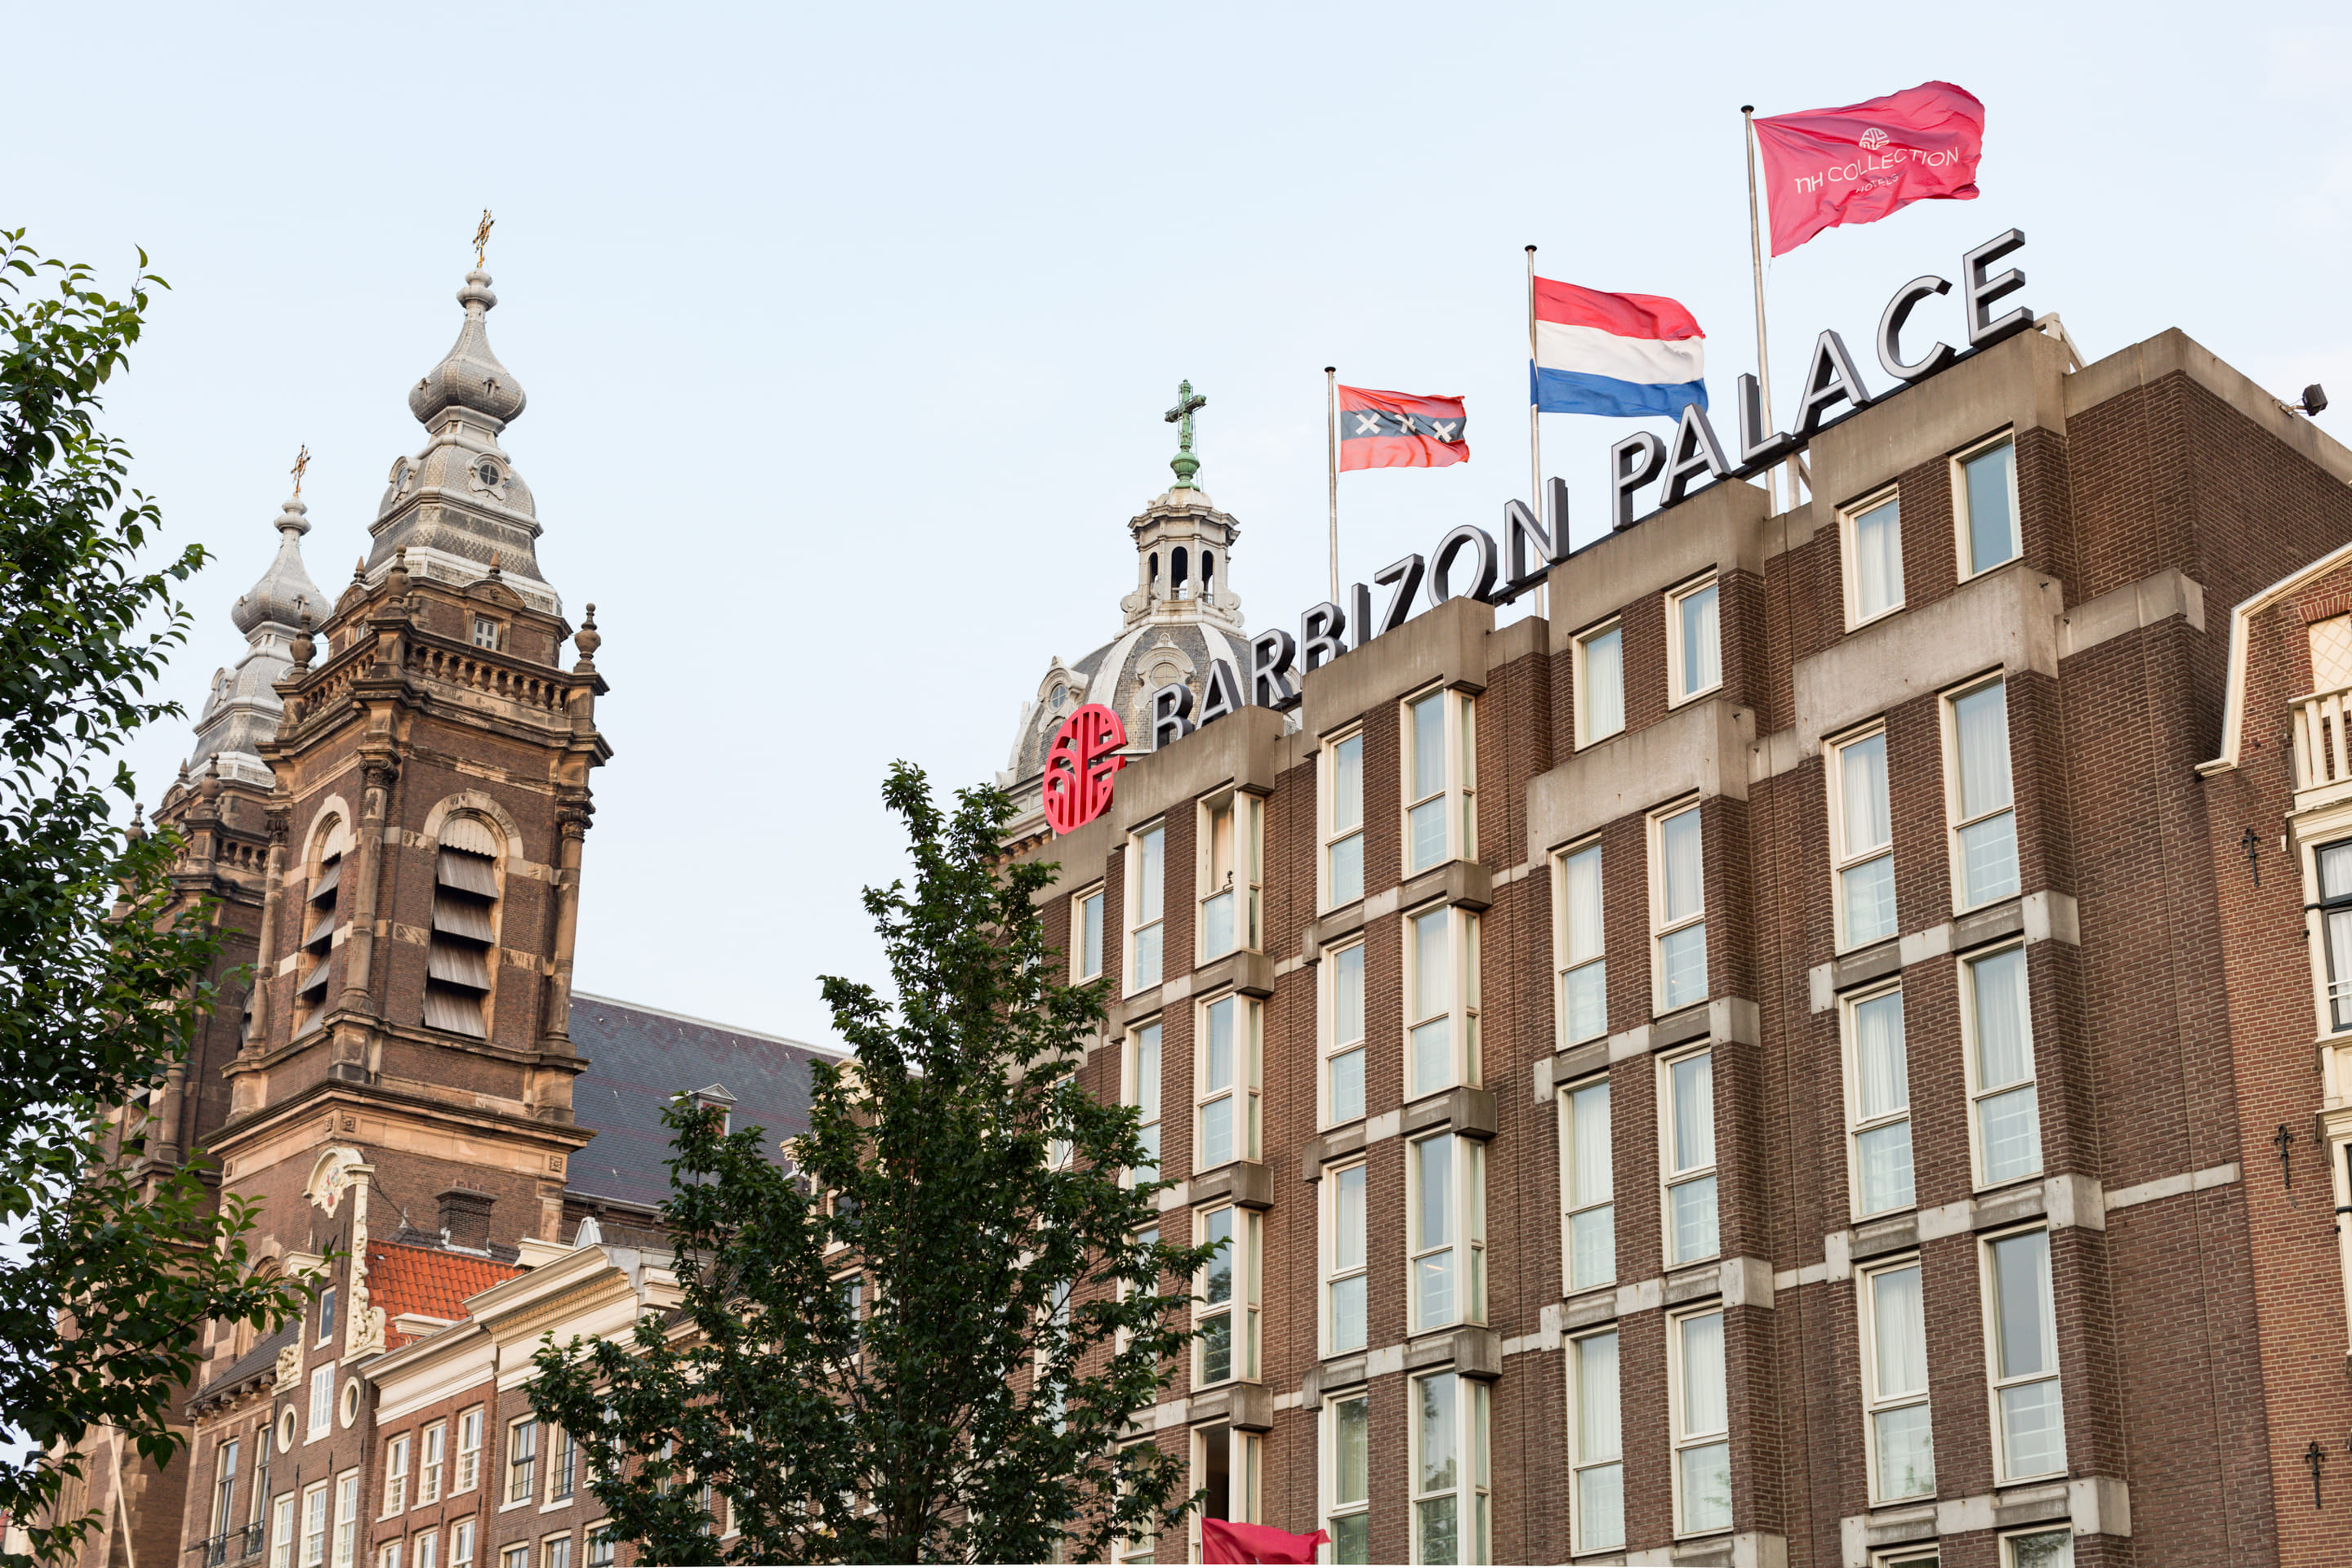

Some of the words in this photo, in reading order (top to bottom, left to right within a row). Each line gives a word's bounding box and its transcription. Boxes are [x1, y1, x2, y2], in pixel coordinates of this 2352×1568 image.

[1828, 146, 1959, 182] COLLECTION
[1855, 173, 1900, 194] HOTELS
[1152, 476, 1570, 753] BARBIZON
[1611, 228, 2034, 532] PALACE
